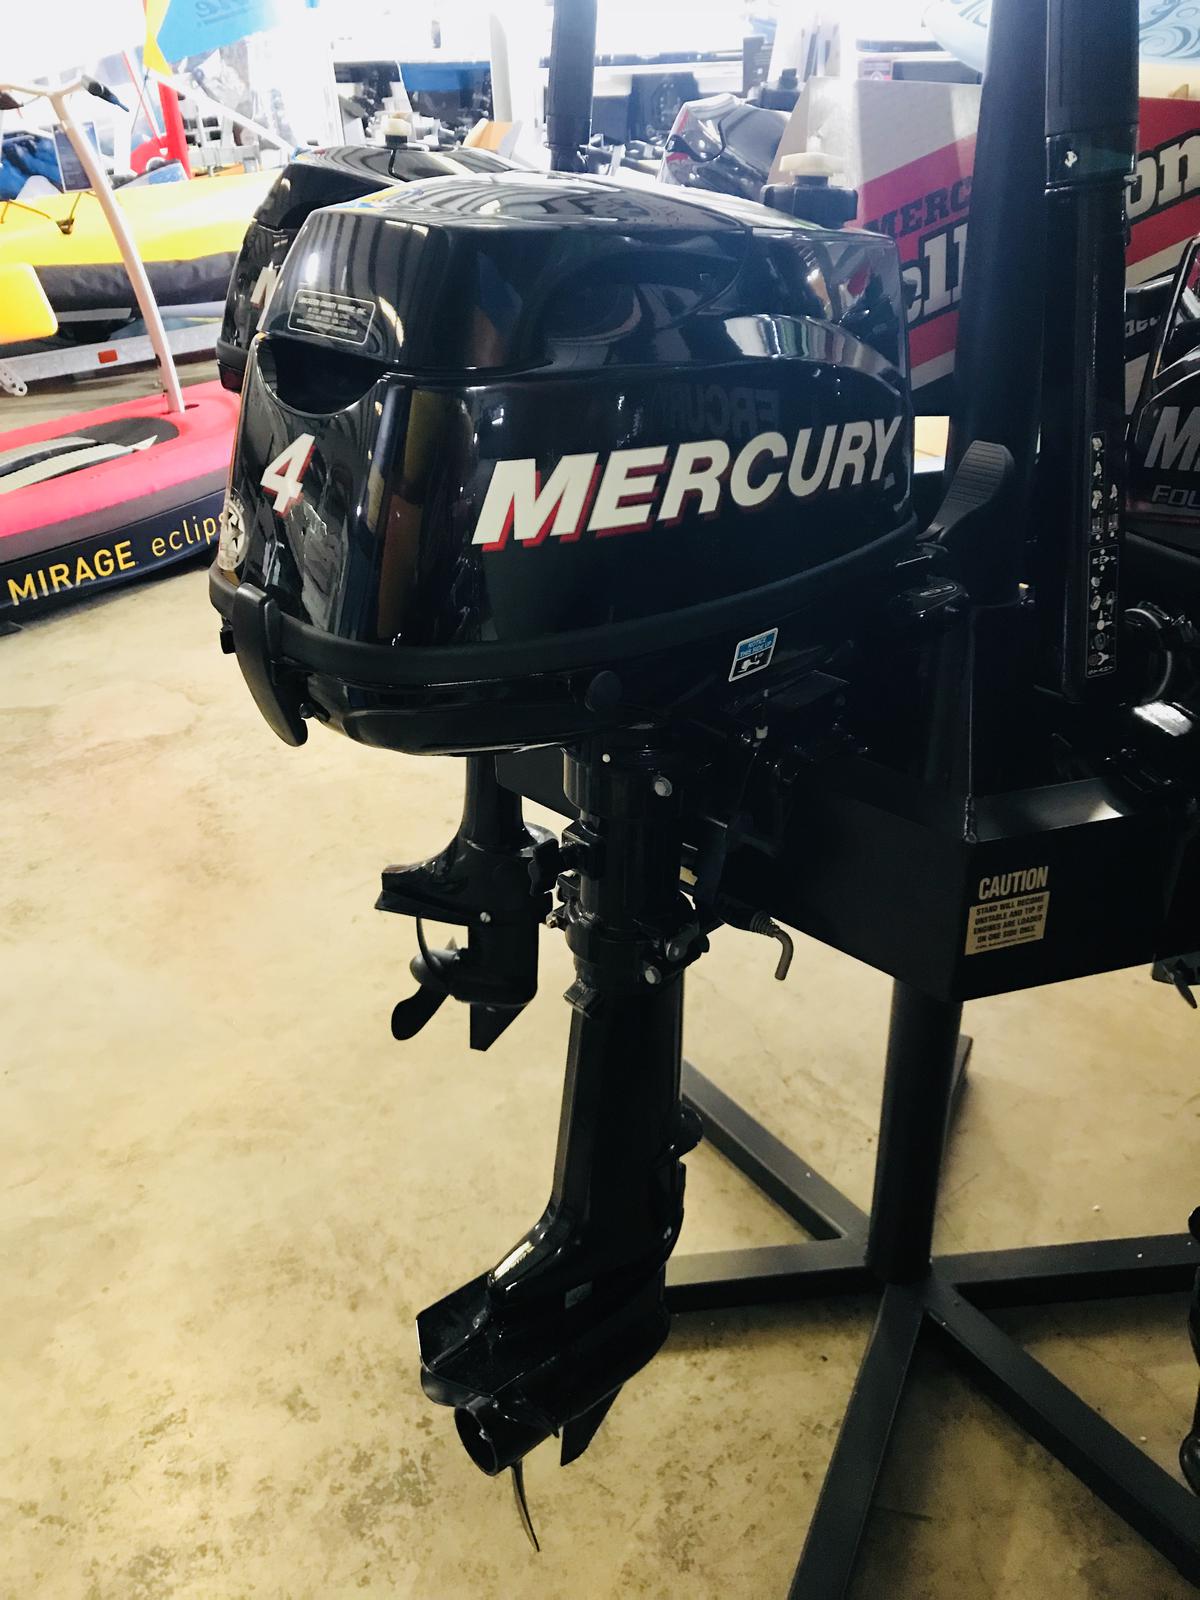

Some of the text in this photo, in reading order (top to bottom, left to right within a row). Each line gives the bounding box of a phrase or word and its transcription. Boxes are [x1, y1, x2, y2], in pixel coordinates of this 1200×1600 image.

[1147, 406, 1200, 471] M
[260, 432, 315, 515] 4
[472, 416, 903, 550] MERCURY
[7, 540, 137, 606] MIRAGE
[978, 866, 1049, 900] CAUTION
[975, 912, 1008, 926] UNSTABLE
[1009, 909, 1023, 918] AND
[1025, 907, 1036, 916] TIP
[976, 895, 1044, 916] STAND WILL BECOME
[973, 914, 1043, 935] ENGINES ARE LOADED
[977, 934, 987, 944] ON
[988, 931, 1001, 941] ONE
[1019, 925, 1036, 935] ONLY
